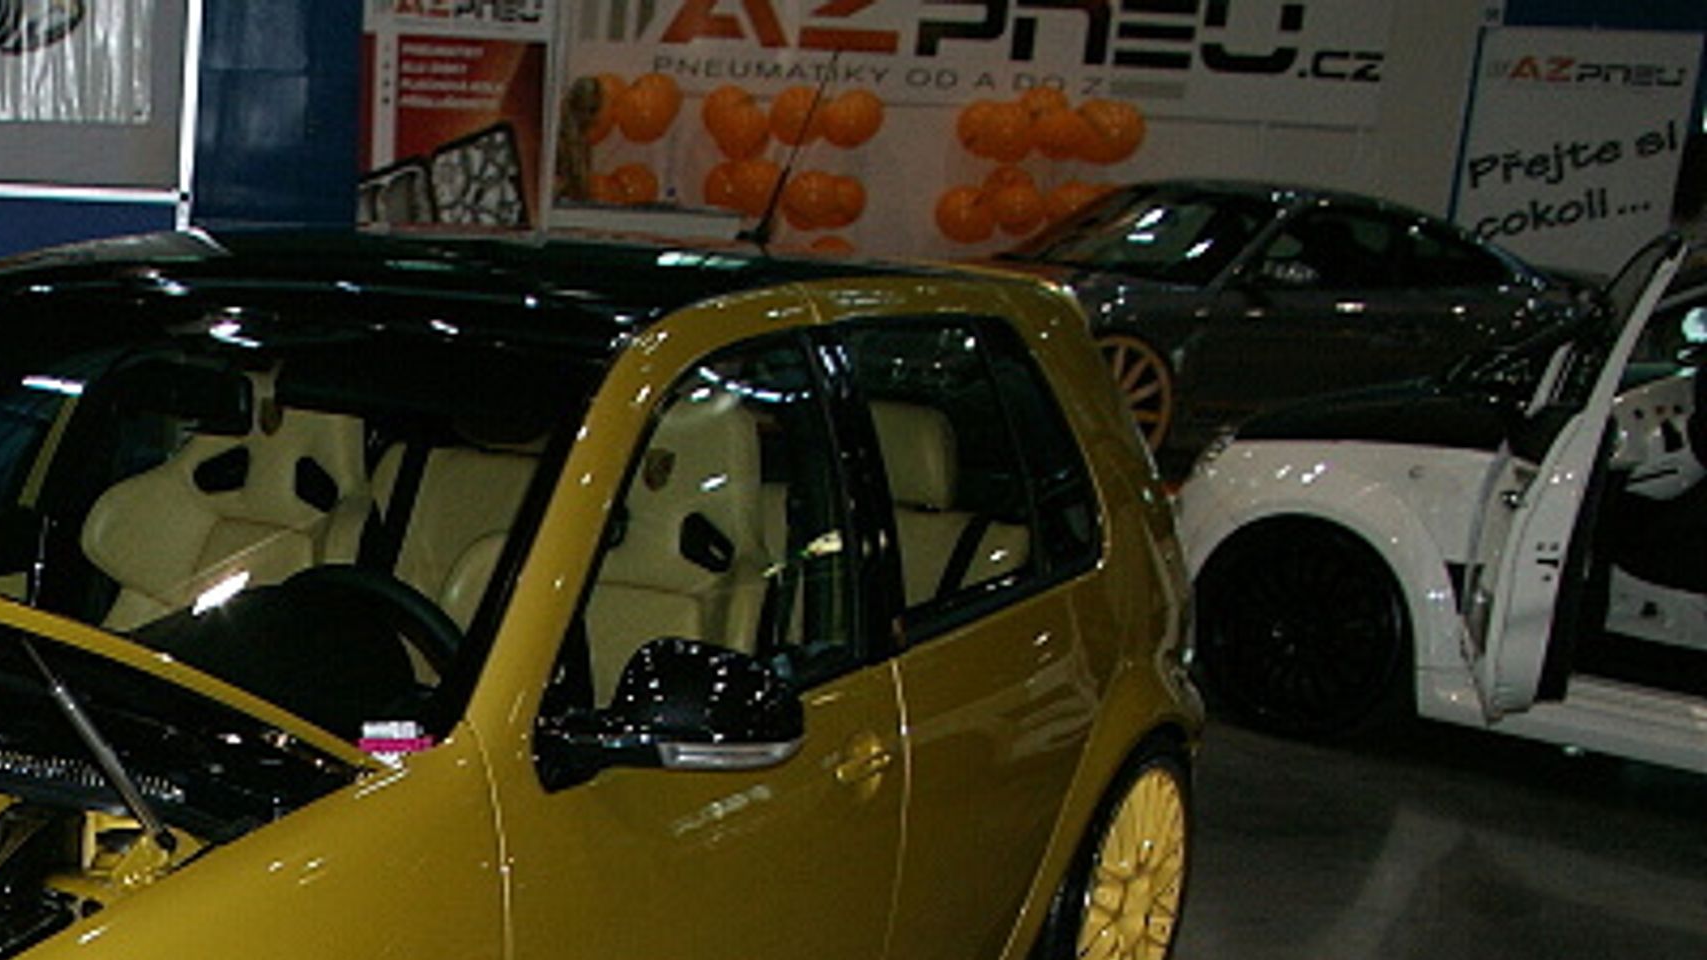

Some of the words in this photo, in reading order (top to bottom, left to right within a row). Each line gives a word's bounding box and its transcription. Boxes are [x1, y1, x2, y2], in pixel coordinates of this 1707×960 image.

[651, 55, 892, 85] PNEUMATIKY
[905, 68, 958, 90] OD
[974, 71, 997, 91] A
[1080, 76, 1104, 97] Z
[1467, 138, 1623, 189] Přejte
[1635, 120, 1678, 159] si
